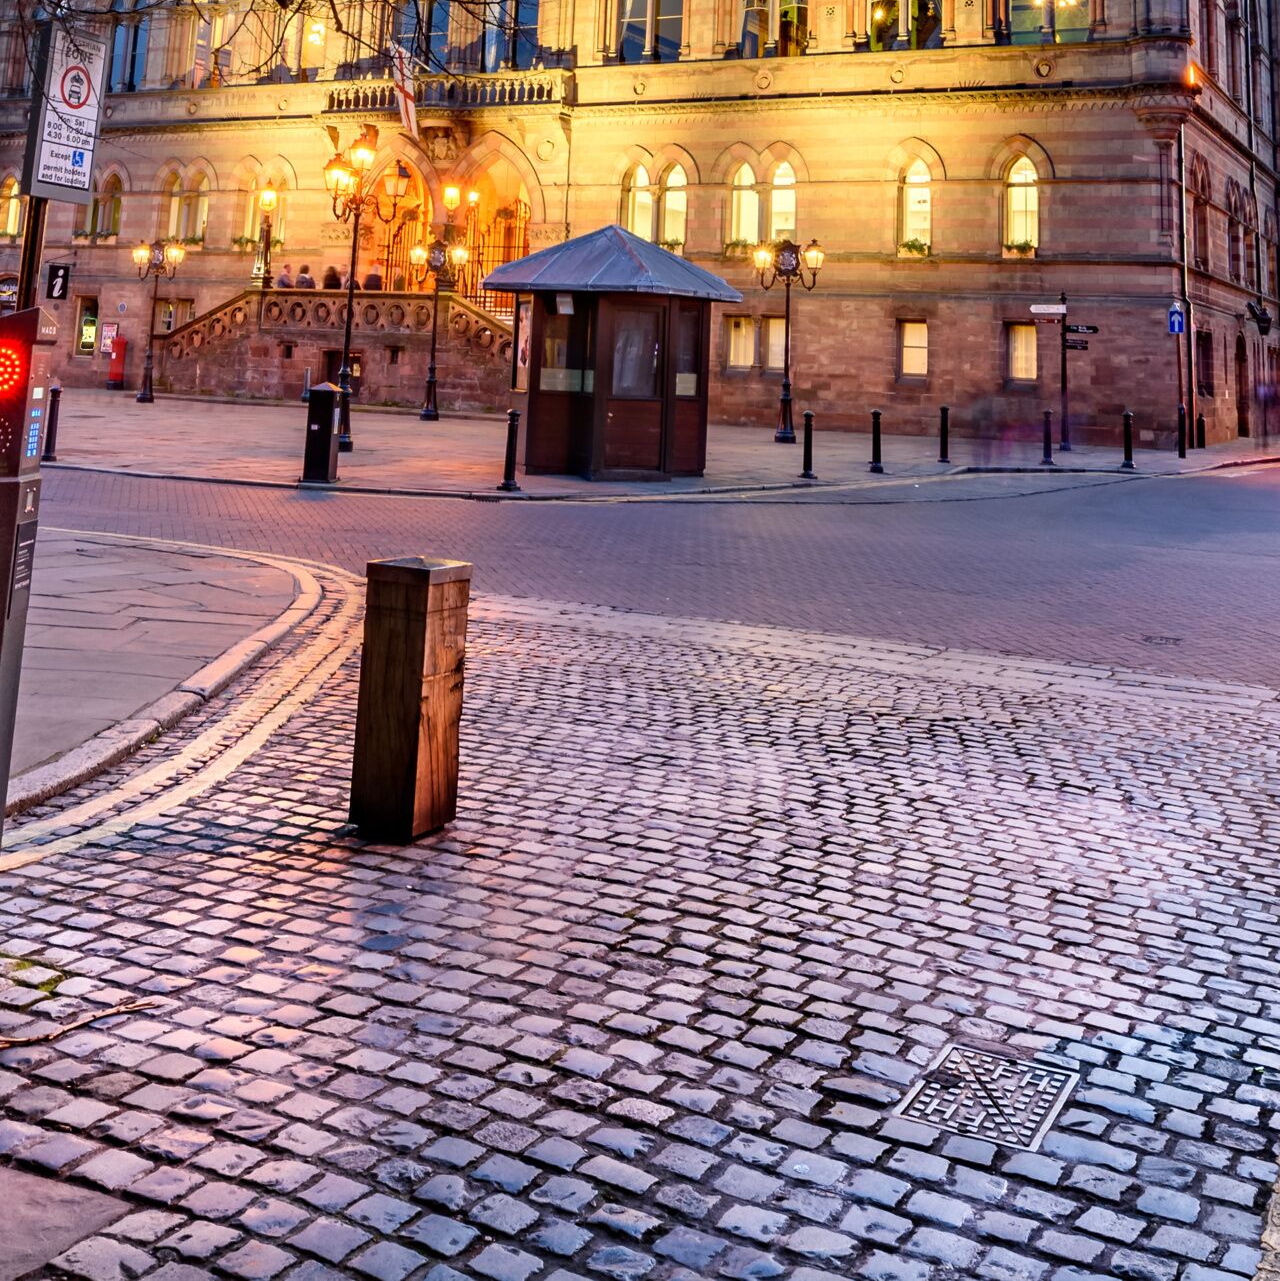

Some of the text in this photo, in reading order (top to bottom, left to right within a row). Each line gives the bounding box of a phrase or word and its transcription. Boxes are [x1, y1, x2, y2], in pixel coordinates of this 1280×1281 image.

[62, 34, 101, 53] PEESTRIAN
[66, 46, 93, 64] ZONE
[74, 118, 85, 127] Sat
[50, 149, 71, 160] Except
[42, 164, 86, 178] permit holders
[54, 174, 63, 182] for
[64, 176, 86, 188] loading
